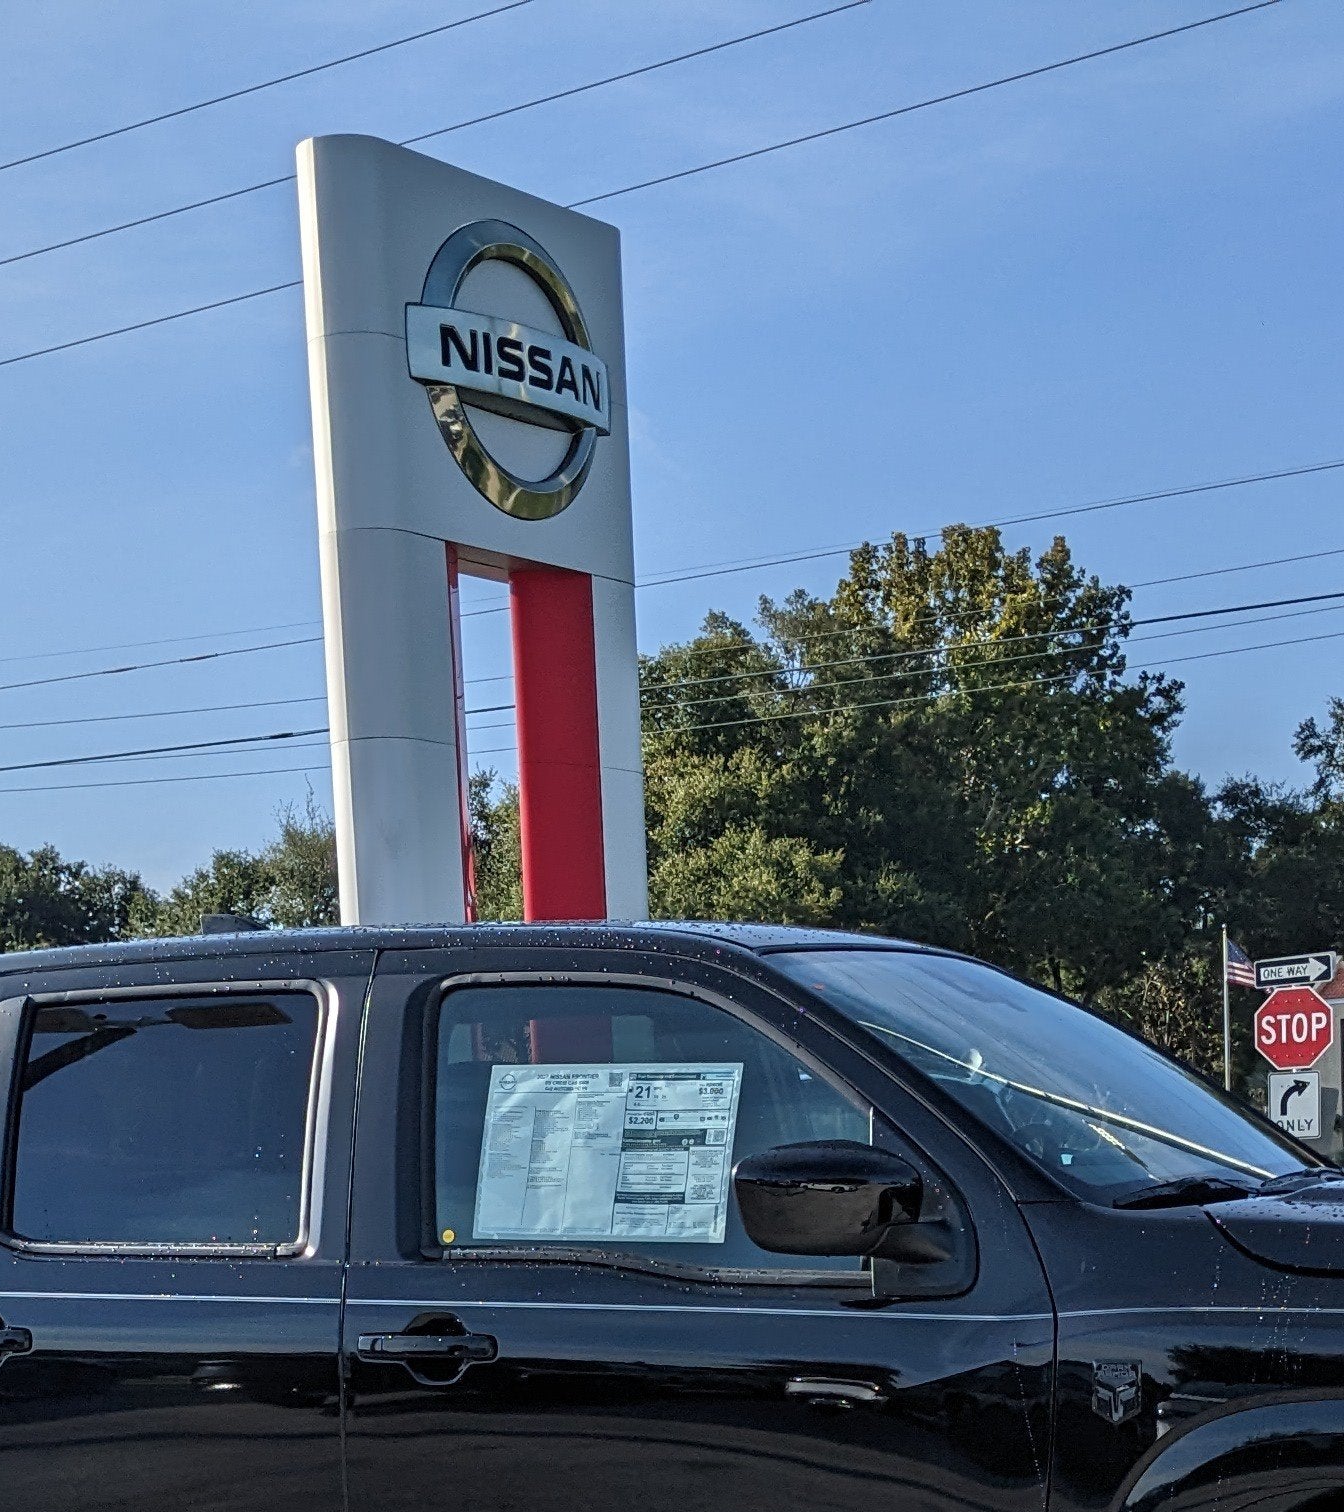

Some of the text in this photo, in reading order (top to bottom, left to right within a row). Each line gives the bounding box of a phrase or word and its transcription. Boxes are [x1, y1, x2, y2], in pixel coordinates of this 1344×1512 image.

[439, 323, 603, 413] NISSAN
[1262, 965, 1308, 980] ONE WAY
[1260, 1012, 1328, 1045] STOP
[634, 1085, 651, 1099] 21
